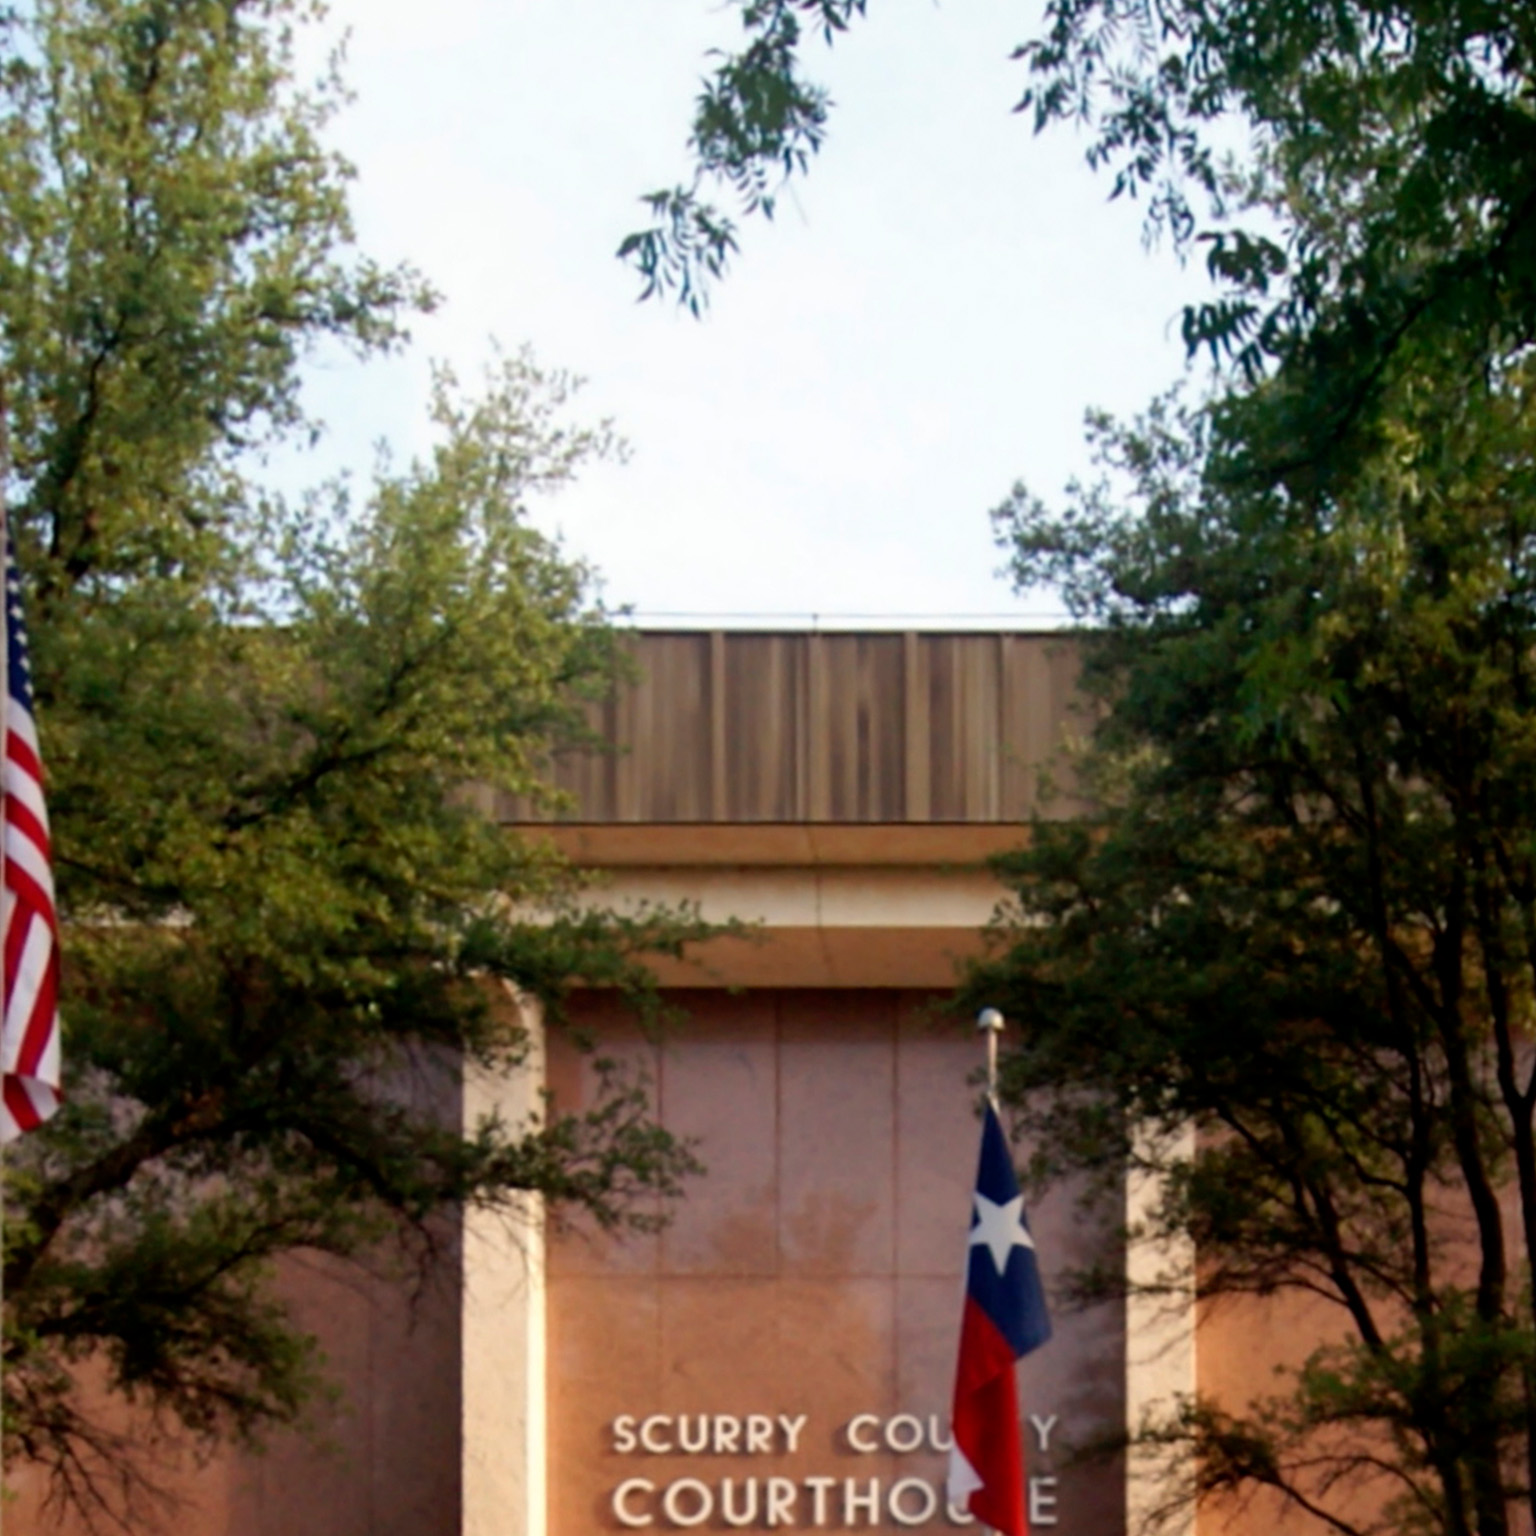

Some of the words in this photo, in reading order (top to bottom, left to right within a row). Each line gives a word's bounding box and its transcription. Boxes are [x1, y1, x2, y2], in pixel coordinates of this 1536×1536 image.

[613, 1414, 807, 1452] SCURRY
[846, 1414, 1057, 1452] COUY
[612, 1477, 1058, 1525] COURTHOE
